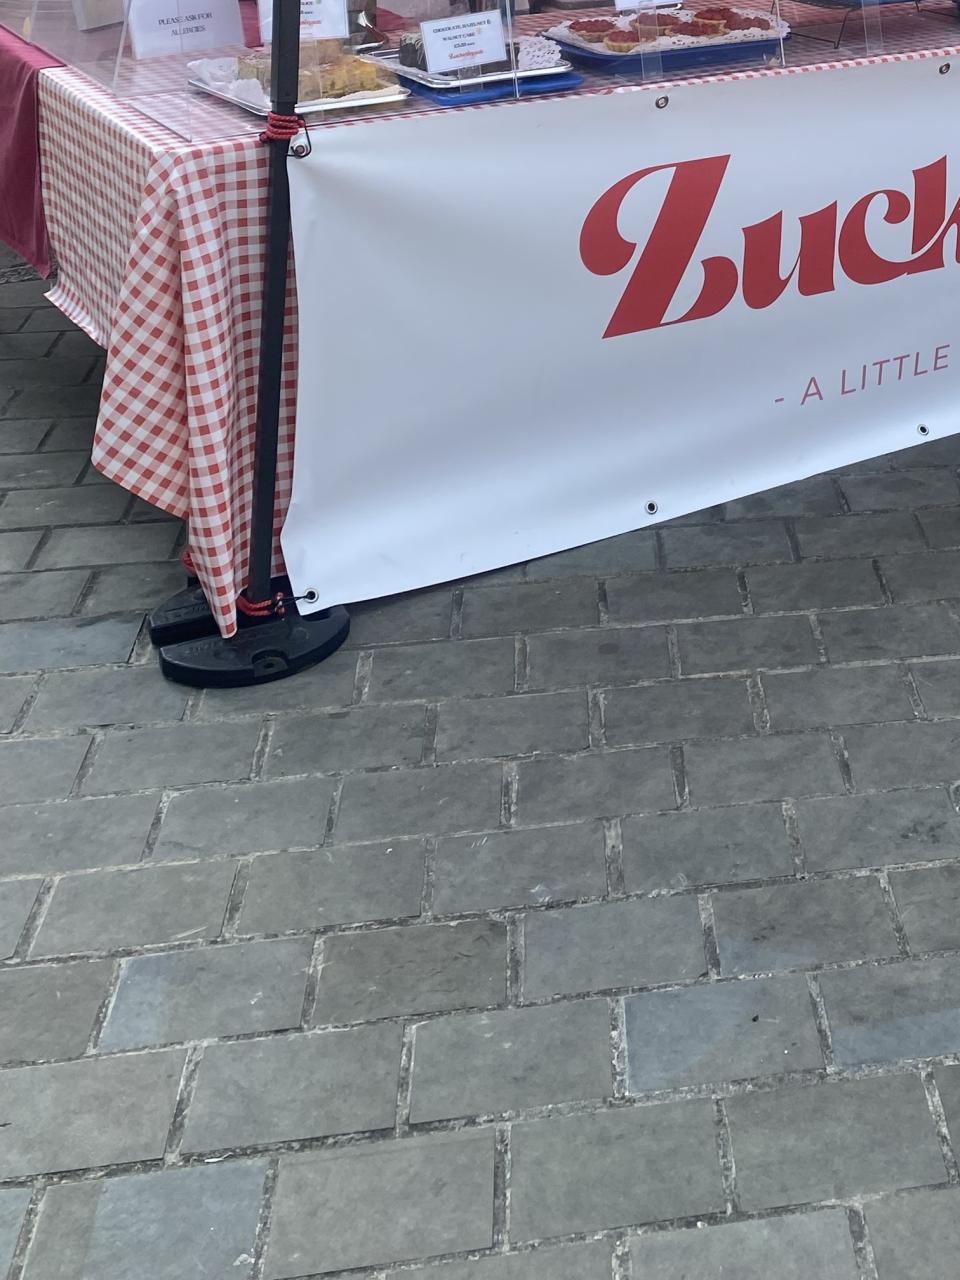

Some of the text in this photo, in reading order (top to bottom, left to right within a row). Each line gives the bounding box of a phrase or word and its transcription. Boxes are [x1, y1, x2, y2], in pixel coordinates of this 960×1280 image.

[159, 12, 212, 25] PLEASE ASK FOR
[801, 376, 823, 406] A
[841, 344, 951, 396] LITTLE
